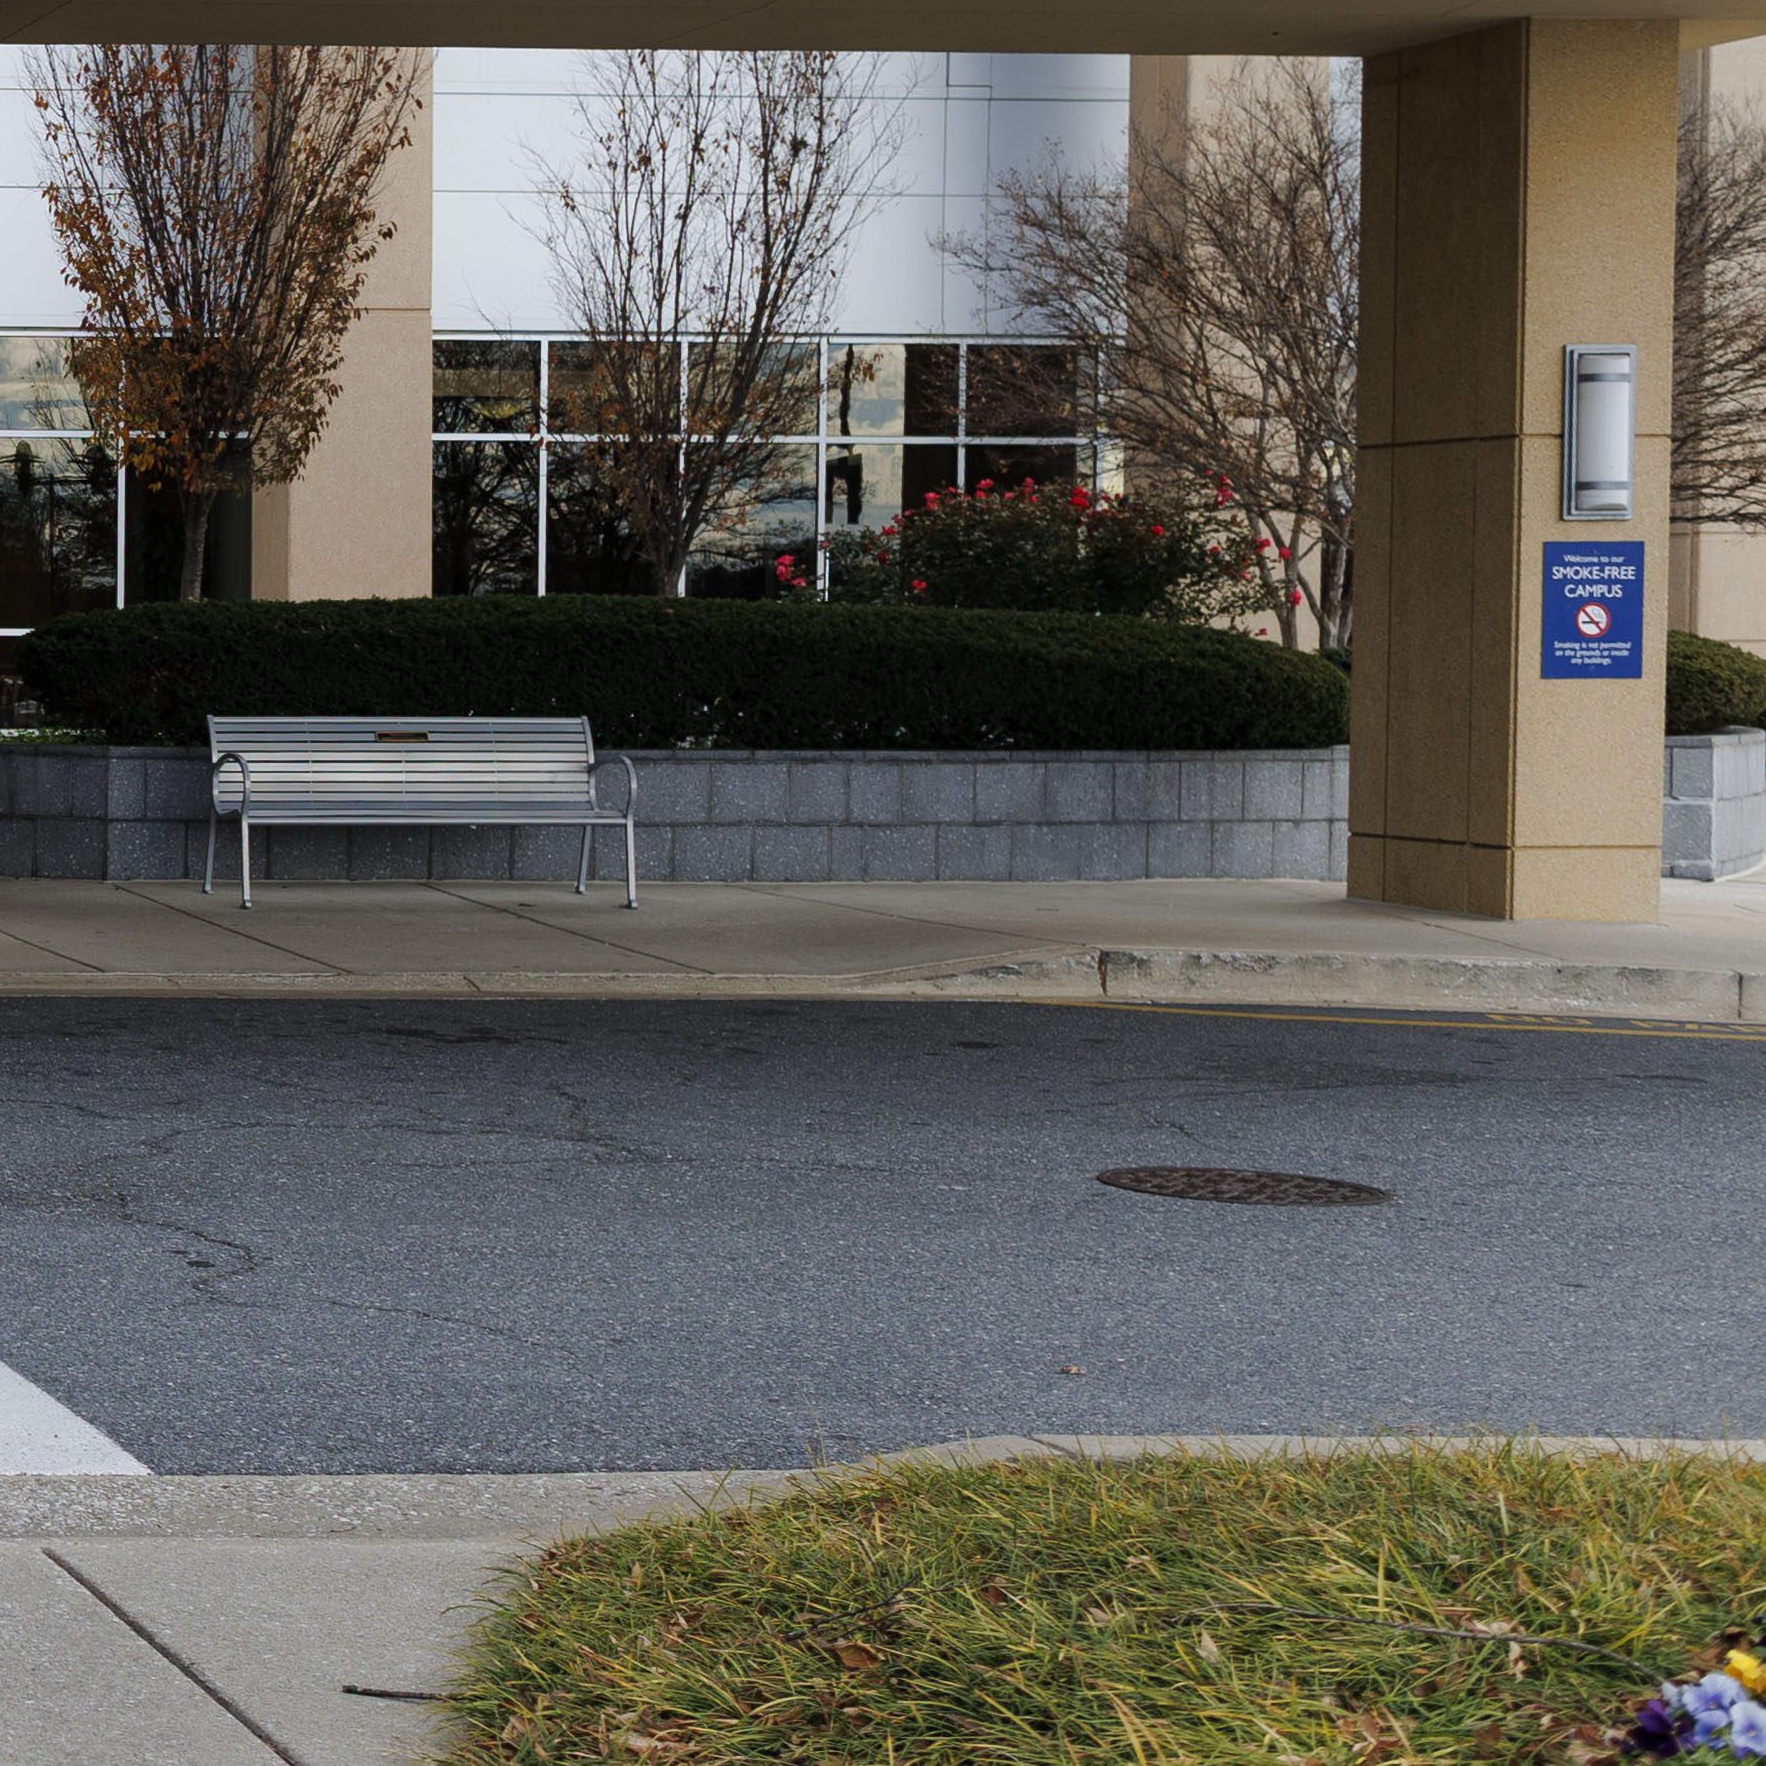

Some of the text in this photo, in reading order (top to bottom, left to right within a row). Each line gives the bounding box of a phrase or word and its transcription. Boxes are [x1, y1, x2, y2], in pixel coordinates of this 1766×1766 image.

[1563, 553, 1598, 563] Welcome
[1600, 555, 1609, 563] to
[1551, 566, 1636, 580] SMOKE-FREE
[1564, 584, 1623, 598] CAMPUS
